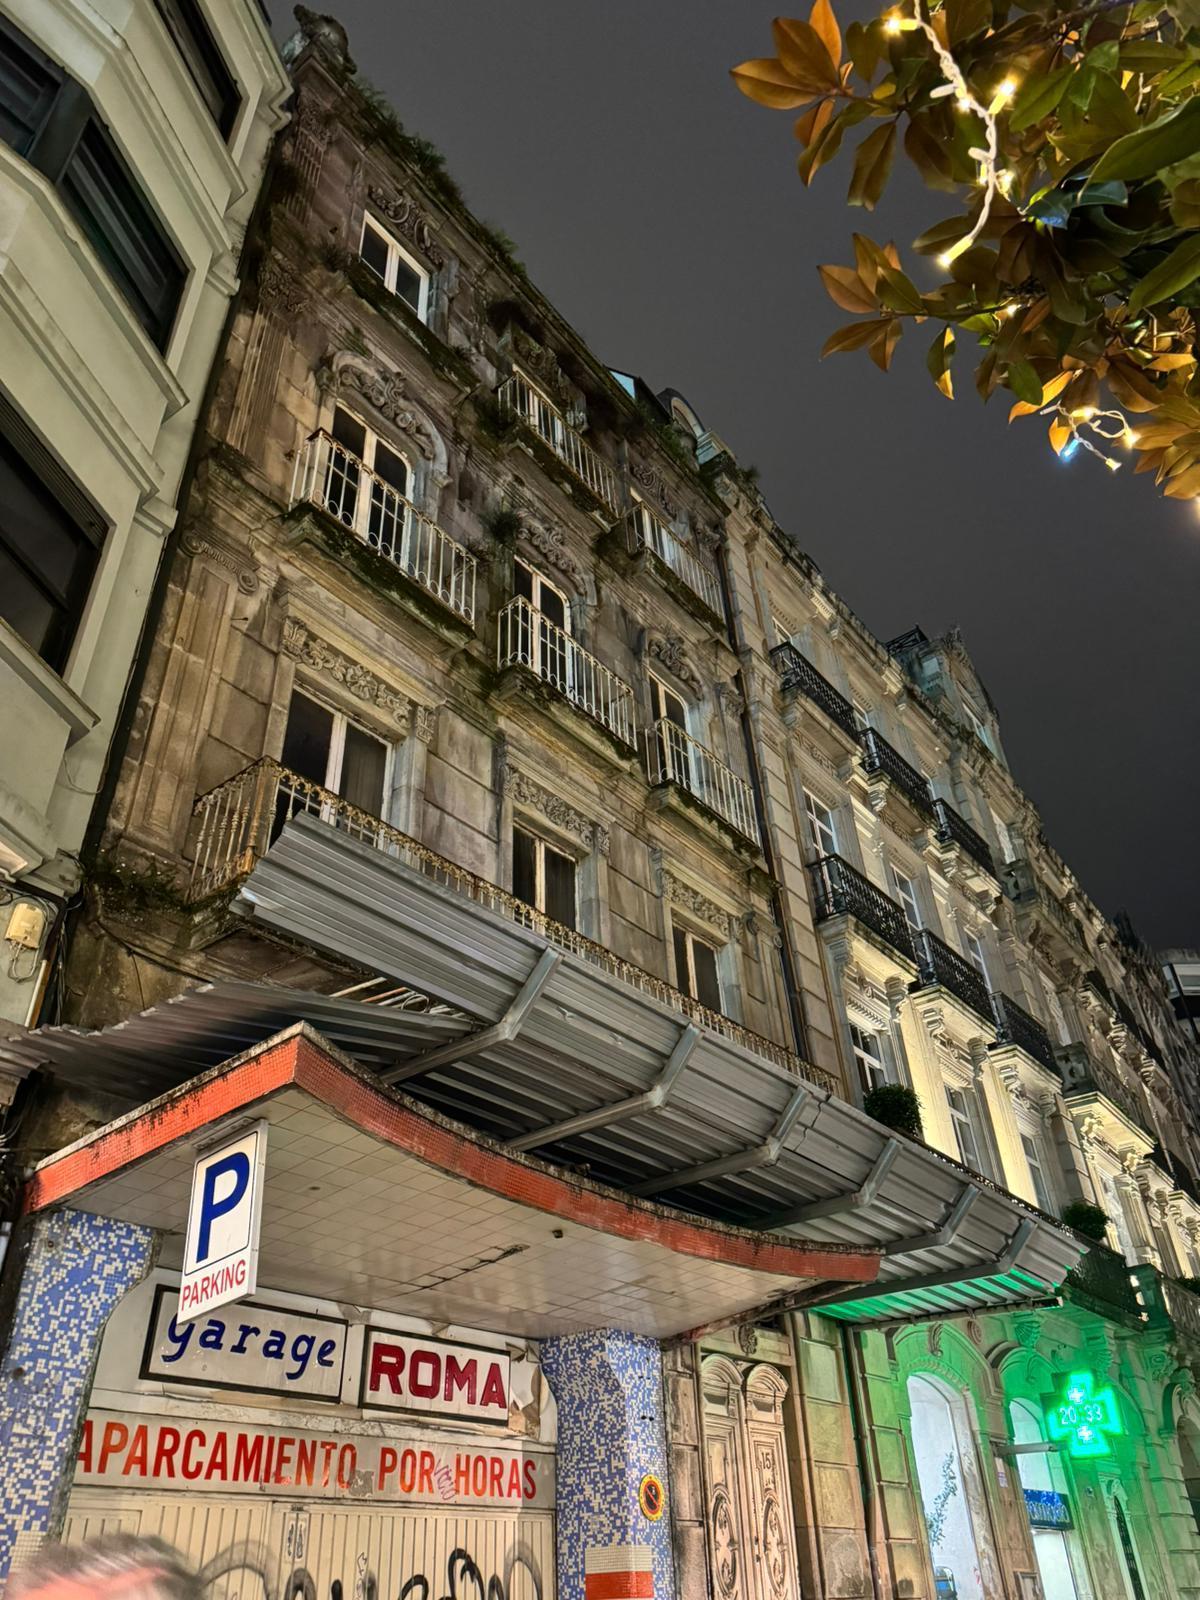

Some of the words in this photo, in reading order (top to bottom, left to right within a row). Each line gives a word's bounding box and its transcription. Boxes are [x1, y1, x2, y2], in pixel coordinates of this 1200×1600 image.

[196, 1152, 250, 1264] P
[181, 1259, 246, 1312] PARKING
[161, 1312, 336, 1380] garage
[369, 1341, 507, 1409] ROMA
[76, 1419, 357, 1489] APARCAMIENTO
[378, 1447, 436, 1494] POR
[455, 1453, 537, 1500] HORAS
